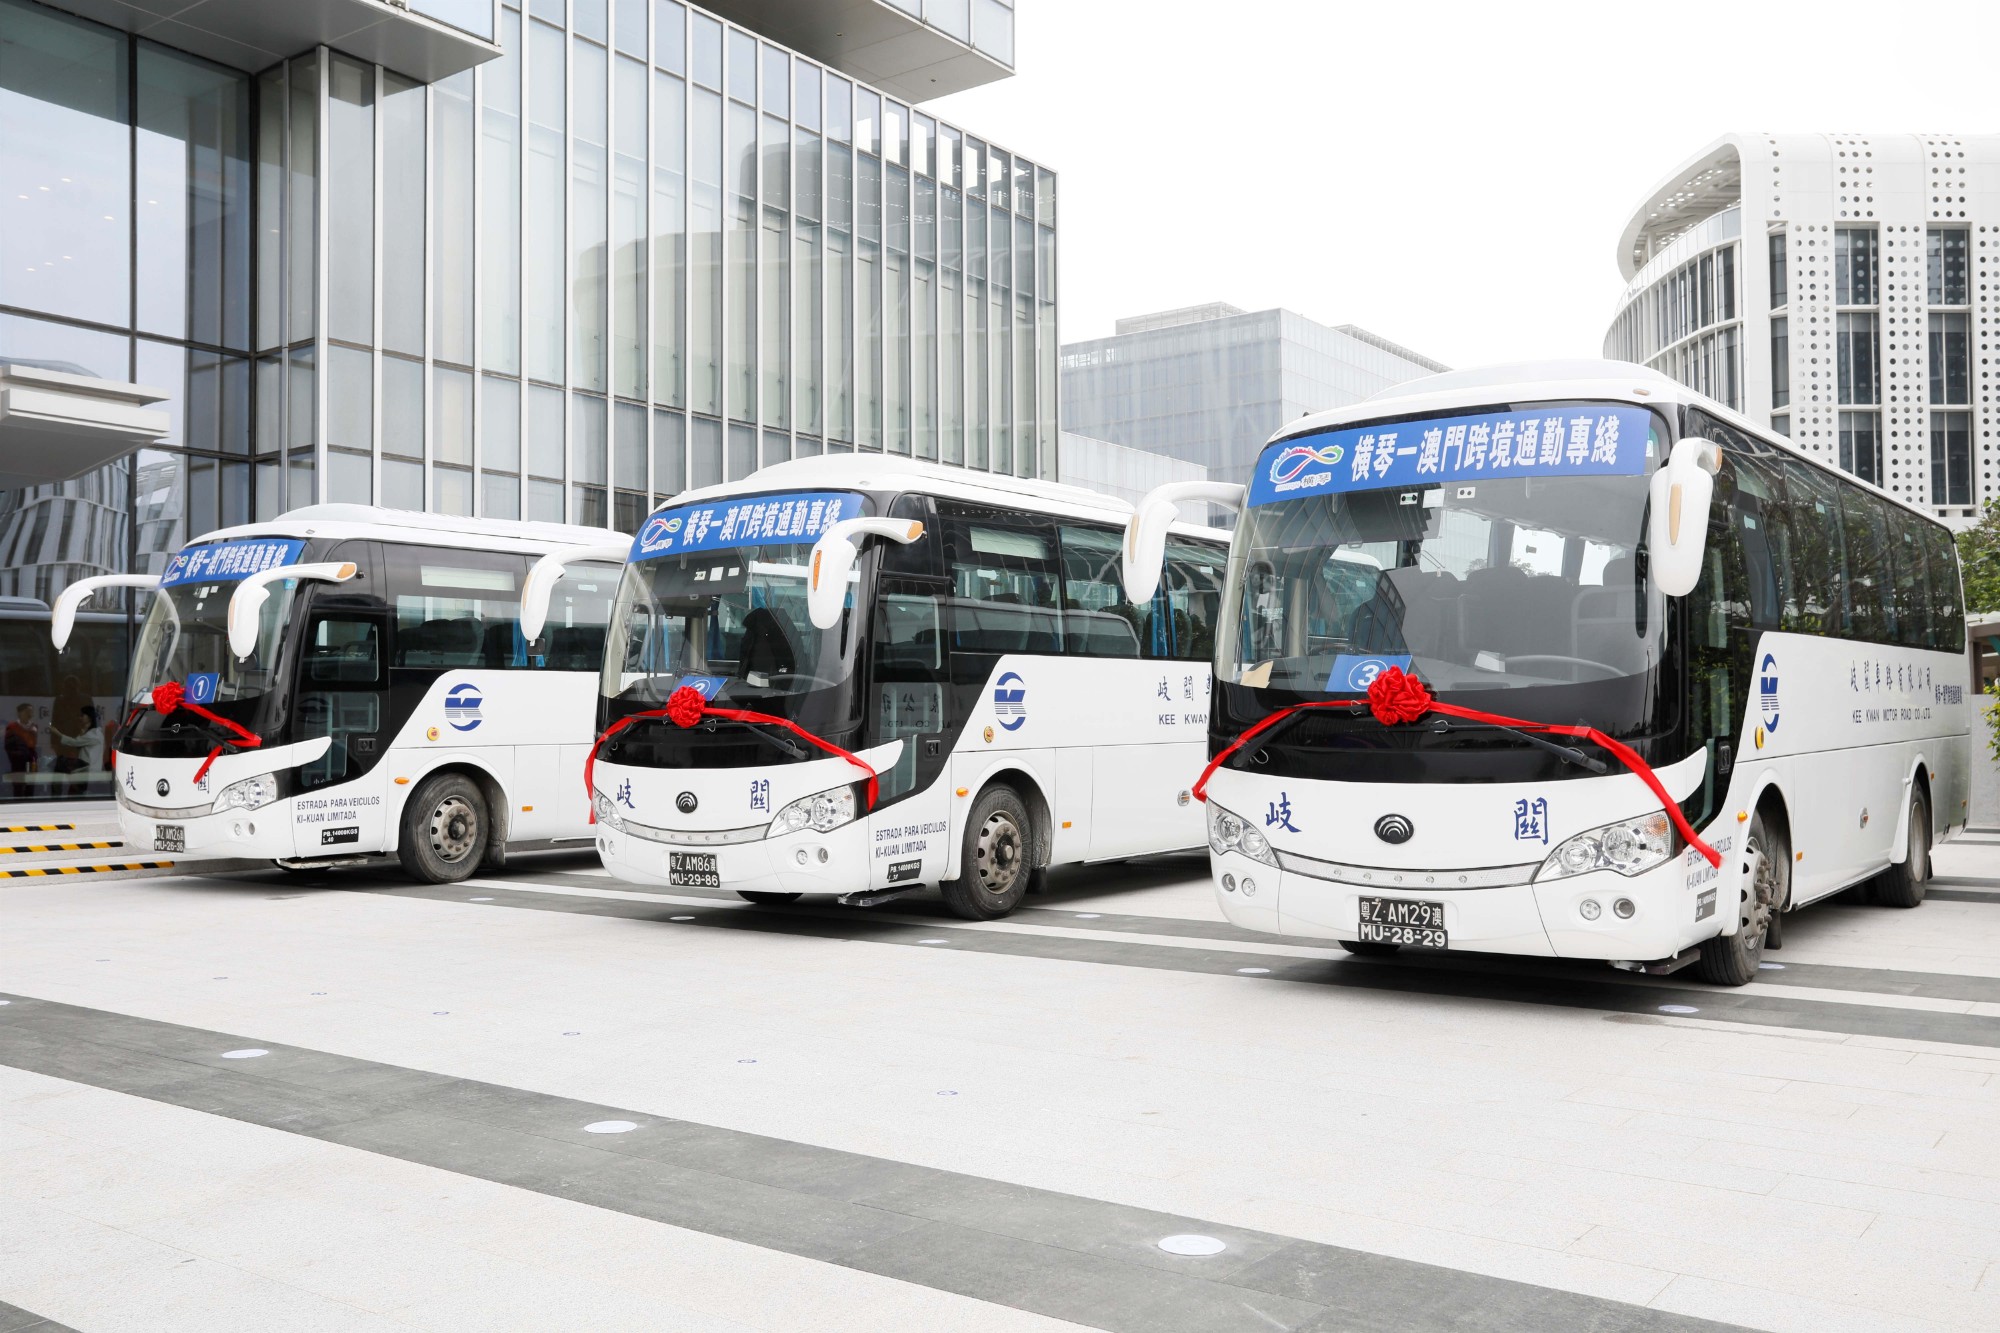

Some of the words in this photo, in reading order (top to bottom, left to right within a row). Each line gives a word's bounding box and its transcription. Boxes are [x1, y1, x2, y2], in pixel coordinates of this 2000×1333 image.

[1357, 664, 1380, 686] 3
[1158, 713, 1176, 725] KEE
[297, 800, 328, 810] ESTRADA
[330, 798, 348, 807] PARA
[348, 796, 380, 807] VEICULOS
[1265, 791, 1301, 833] 岐
[296, 812, 325, 823] KI-KUAN
[327, 810, 357, 822] LIMITADA
[876, 827, 902, 841] ESTRADA
[904, 824, 919, 837] PARA
[920, 820, 947, 835] VEICULOS
[875, 843, 900, 858] KI-KUAN
[901, 840, 927, 854] LIMITADA
[670, 872, 719, 886] MU-29-86
[1360, 924, 1446, 948] MU-28-29
